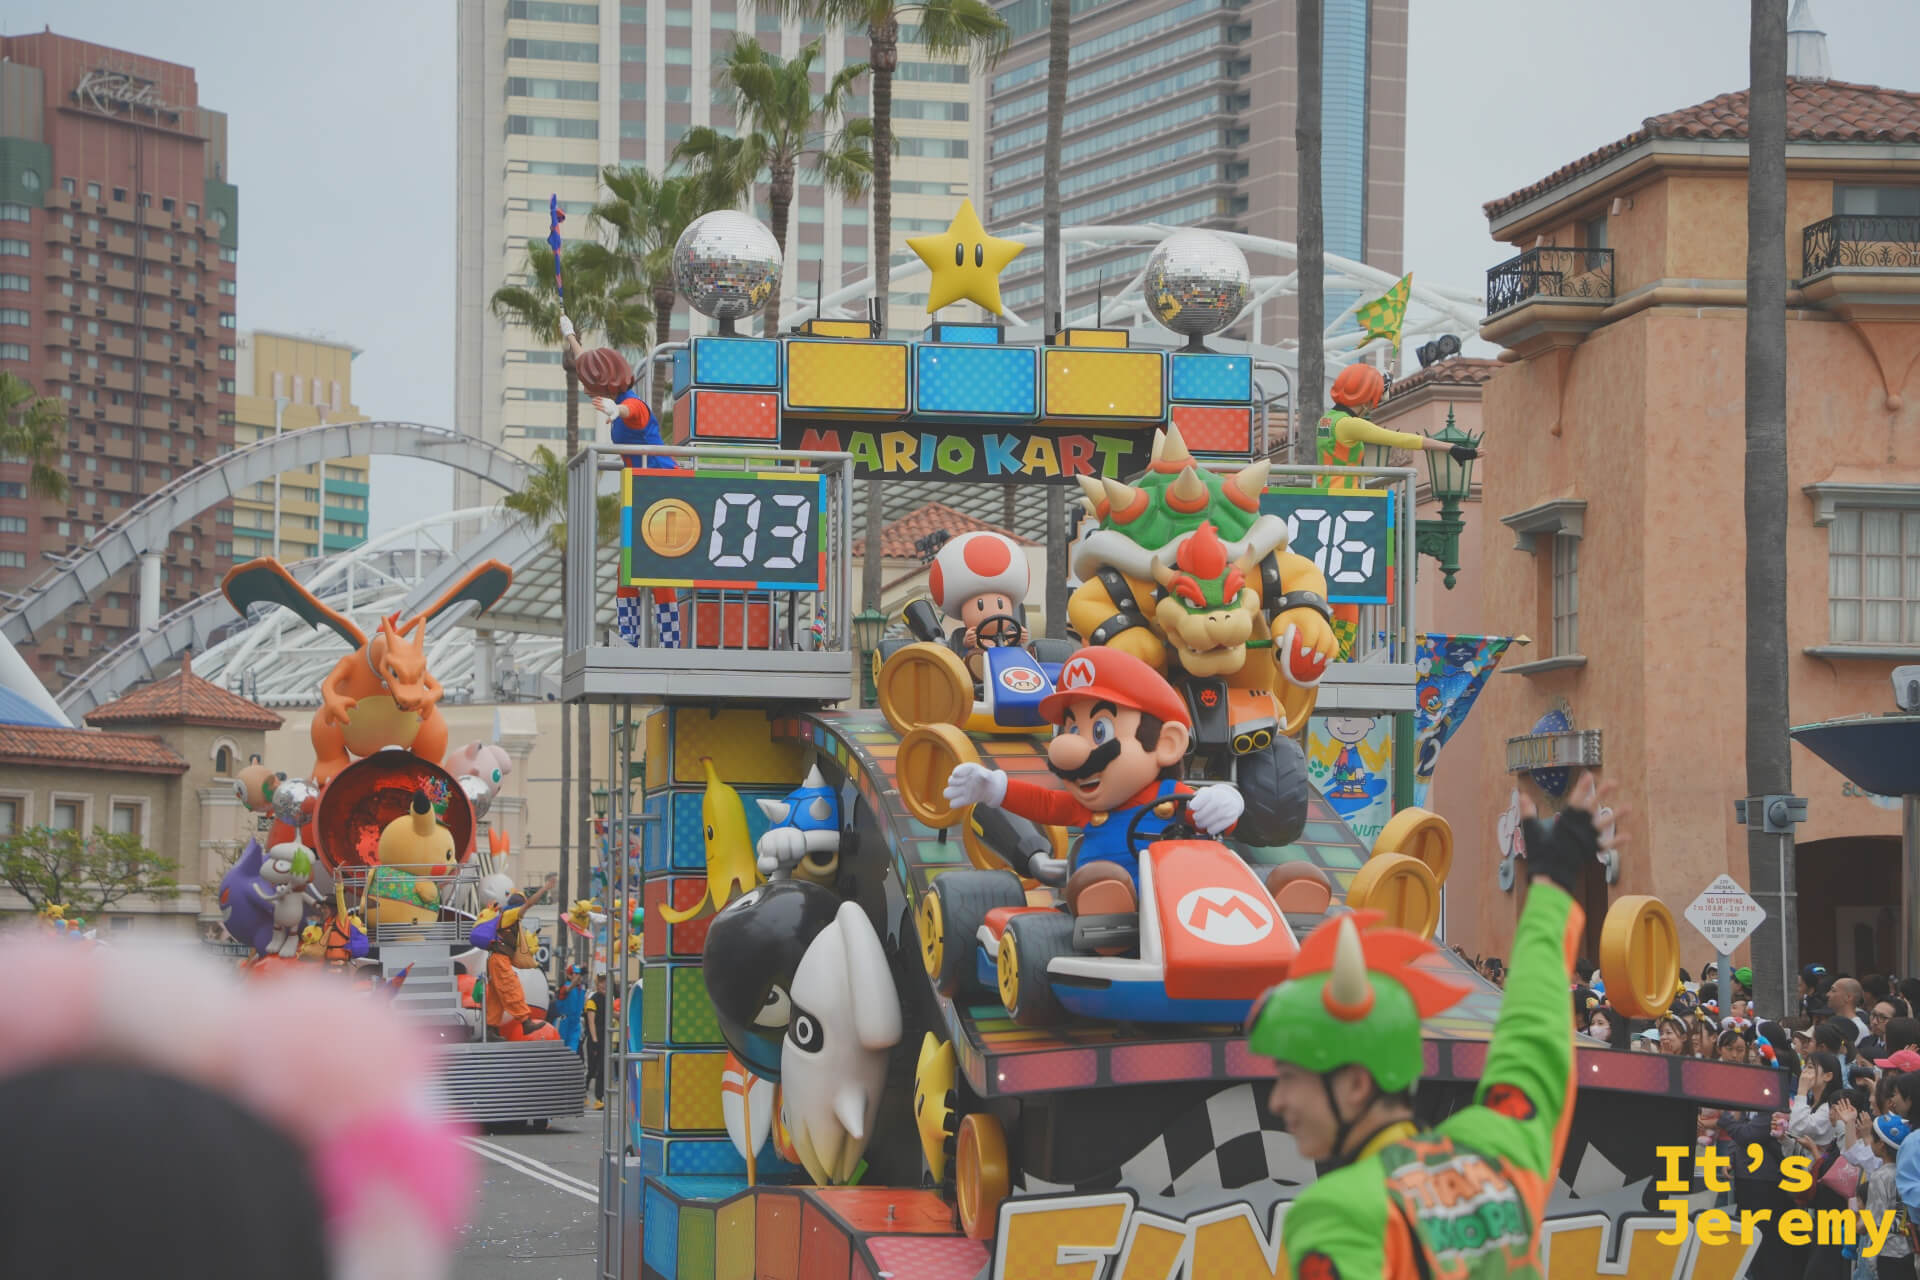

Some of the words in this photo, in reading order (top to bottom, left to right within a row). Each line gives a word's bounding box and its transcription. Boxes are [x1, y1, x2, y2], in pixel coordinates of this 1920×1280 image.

[799, 428, 975, 476] MARIO
[982, 432, 1133, 479] KART
[708, 492, 811, 569] 03
[1716, 897, 1743, 905] STOPPING
